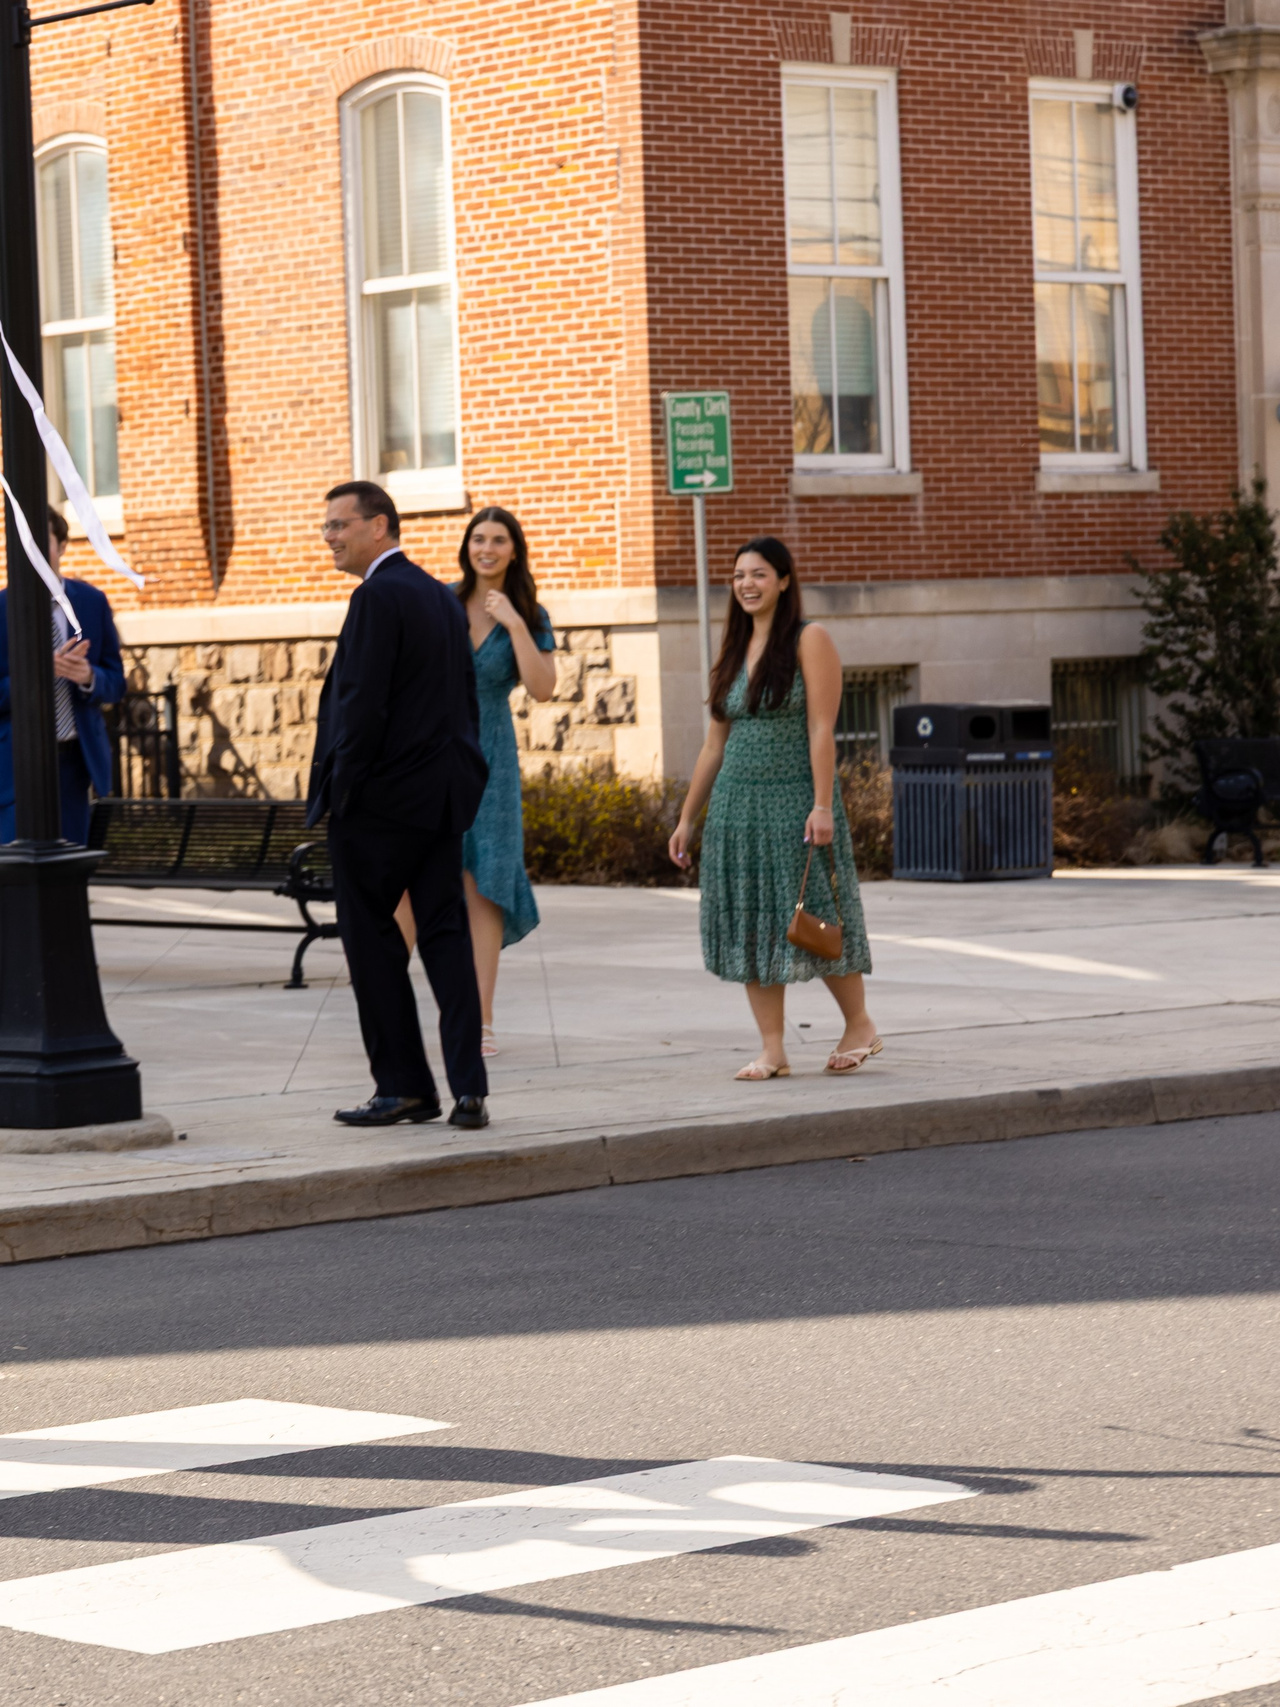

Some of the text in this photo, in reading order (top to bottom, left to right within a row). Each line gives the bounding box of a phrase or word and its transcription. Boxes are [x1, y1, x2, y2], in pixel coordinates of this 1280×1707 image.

[670, 397, 726, 421] County Clerk
[676, 422, 714, 436] Passports
[676, 438, 714, 453] Recording
[677, 454, 726, 469] Search Room
